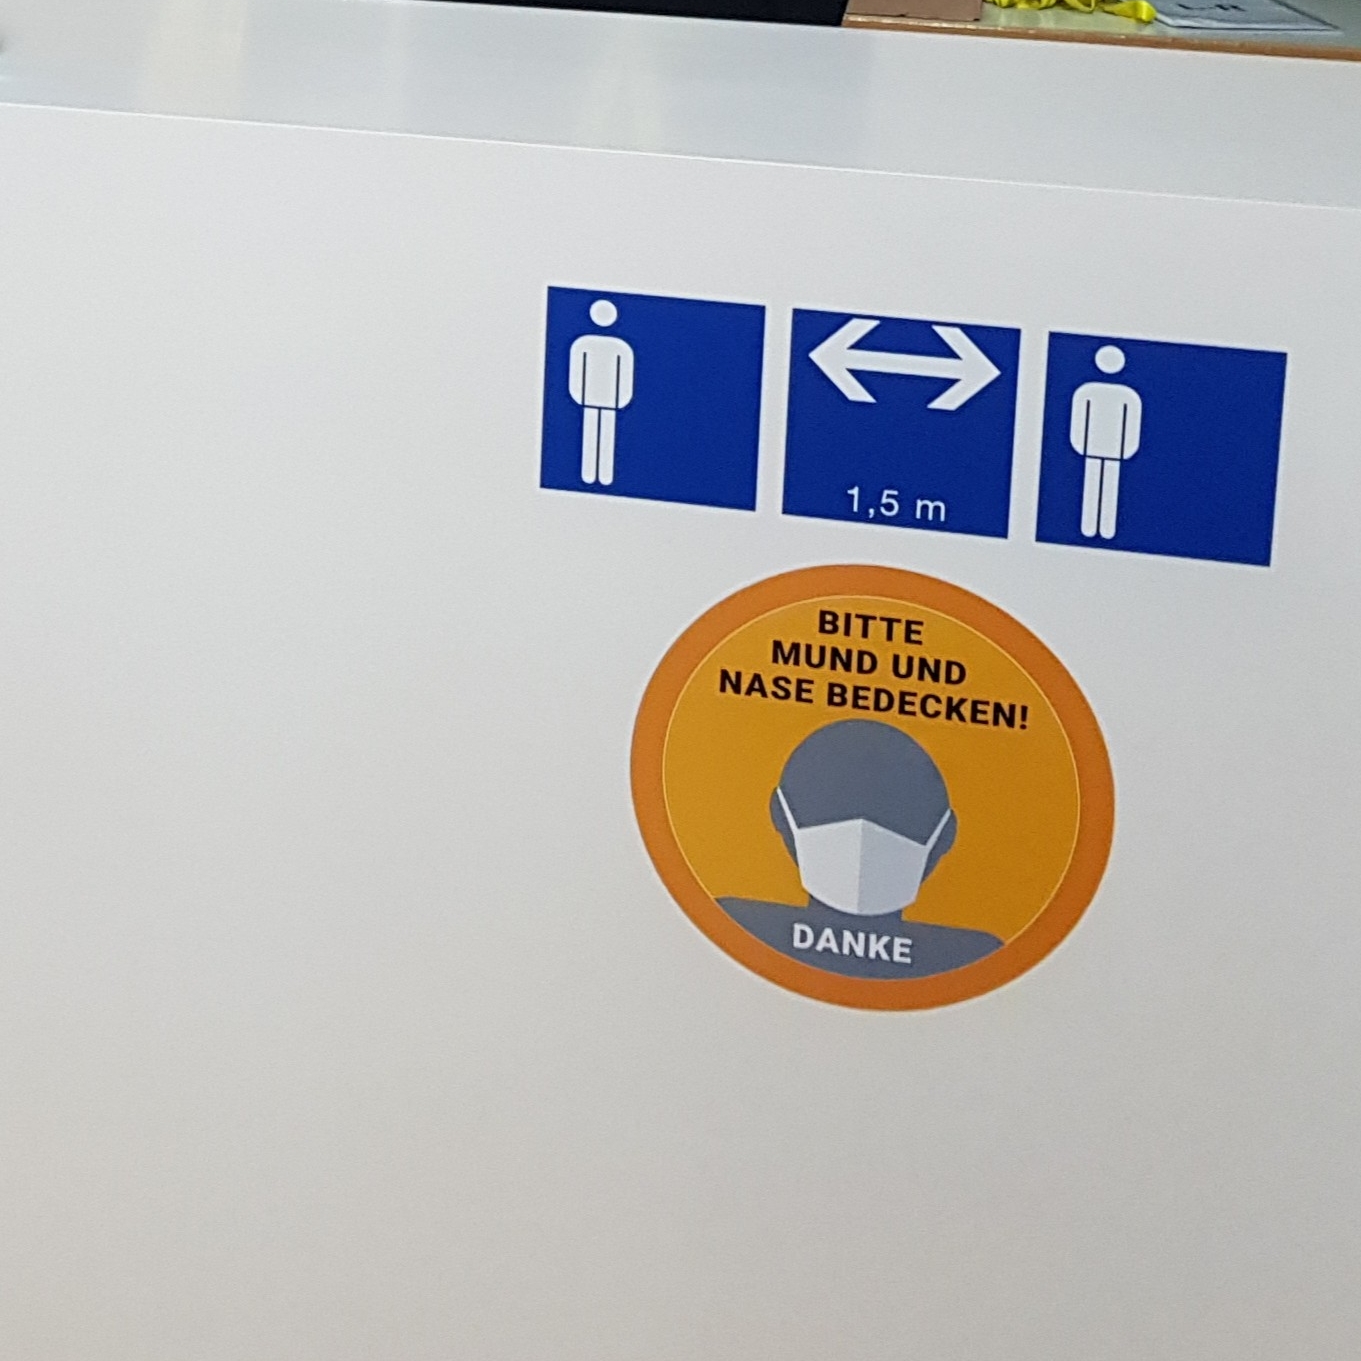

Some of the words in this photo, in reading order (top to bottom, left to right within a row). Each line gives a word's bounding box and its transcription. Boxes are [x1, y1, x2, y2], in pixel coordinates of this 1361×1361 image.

[846, 485, 900, 517] 1,5
[916, 495, 947, 522] m
[818, 609, 925, 646] BITTE
[771, 640, 879, 676] MUND
[891, 653, 967, 686] UND
[718, 668, 815, 703] NASE
[826, 684, 1030, 730] BEDECKEN!
[792, 923, 914, 964] DANKE
